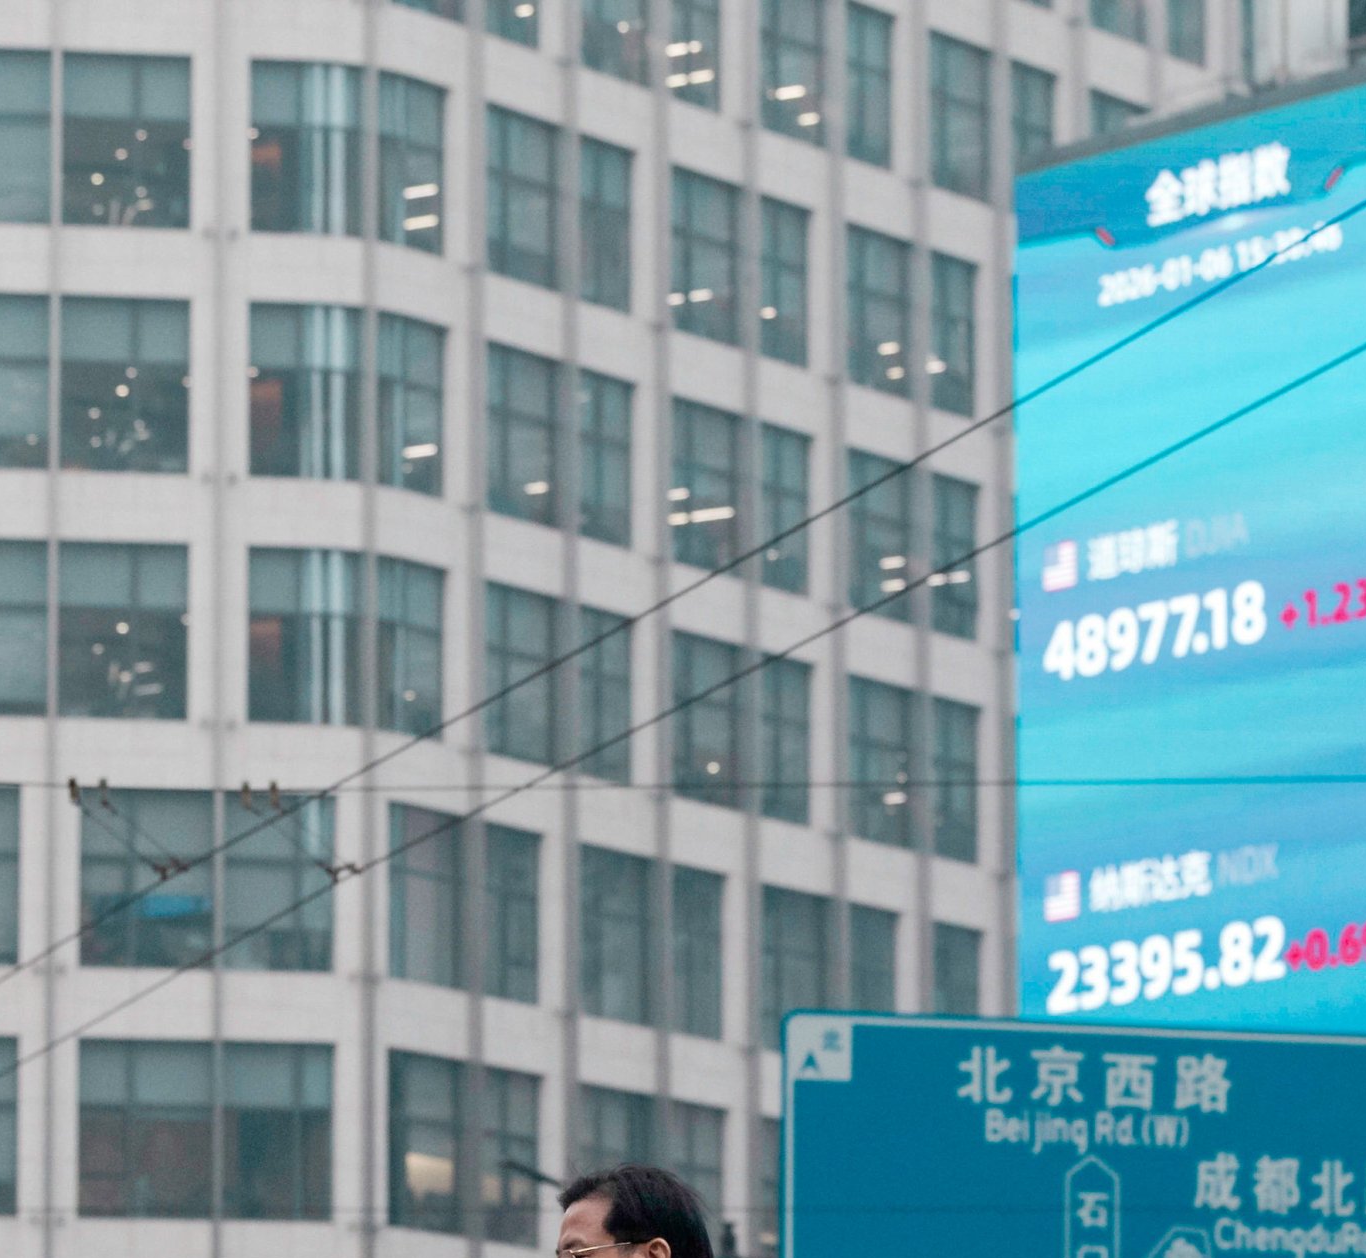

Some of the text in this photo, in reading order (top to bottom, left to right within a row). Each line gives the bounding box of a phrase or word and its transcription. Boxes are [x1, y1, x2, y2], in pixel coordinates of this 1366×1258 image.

[1041, 578, 1269, 682] 48977.18
[1045, 914, 1287, 1016] 23395.82
[957, 1045, 1232, 1114] 北京西路
[985, 1108, 1089, 1155] Beijing
